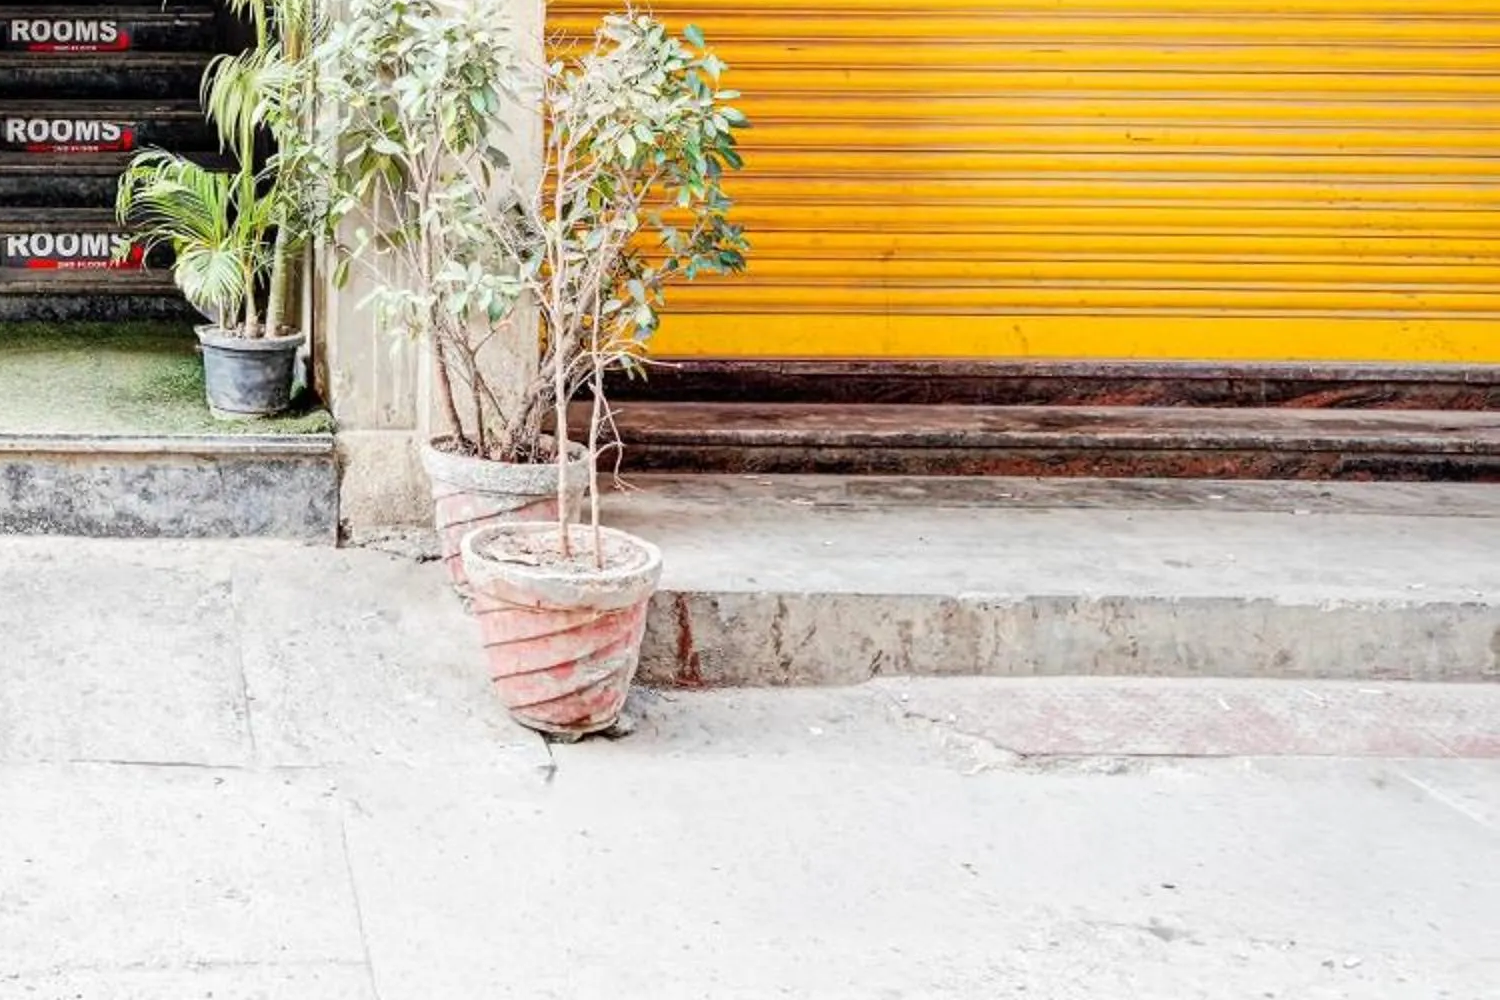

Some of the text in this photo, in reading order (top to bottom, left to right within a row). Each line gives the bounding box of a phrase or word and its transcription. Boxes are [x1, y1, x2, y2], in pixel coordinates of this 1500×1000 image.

[10, 19, 118, 43] ROOMS
[6, 118, 122, 143] ROOMS
[7, 232, 130, 258] ROOMS
